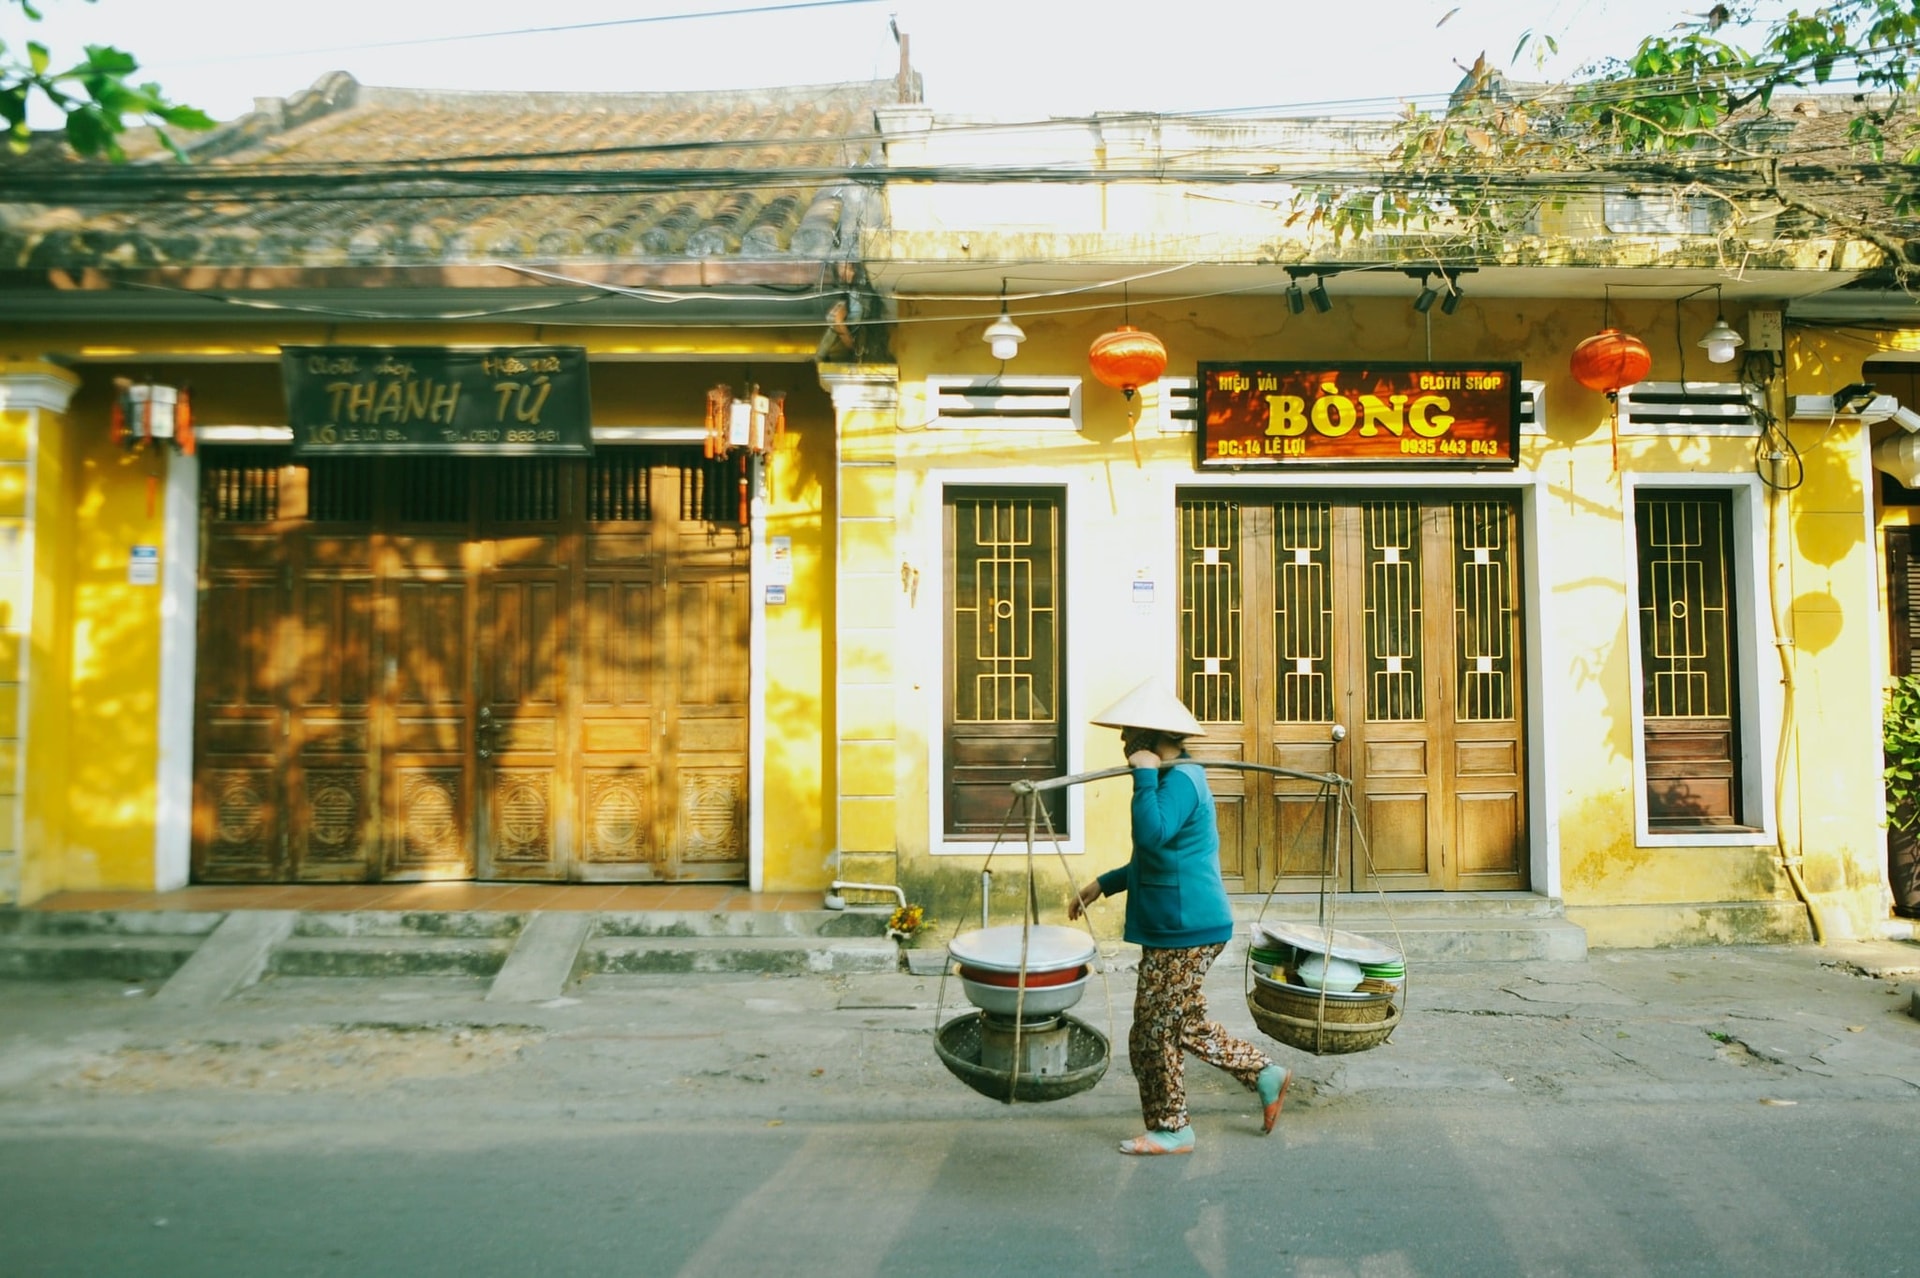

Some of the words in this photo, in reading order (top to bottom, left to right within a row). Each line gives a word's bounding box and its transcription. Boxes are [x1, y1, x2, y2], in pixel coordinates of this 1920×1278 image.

[1219, 374, 1250, 393] HIỆU
[1258, 373, 1277, 391] VẢI
[1420, 375, 1461, 390] CLOTH
[1465, 376, 1501, 390] SHOP
[307, 423, 337, 444] 16
[1245, 439, 1261, 455] 14
[1264, 437, 1282, 454] LÊ
[1283, 438, 1306, 456] LỢI
[1400, 438, 1436, 454] 0935
[1439, 439, 1467, 454] 443
[1471, 439, 1498, 455] 043
